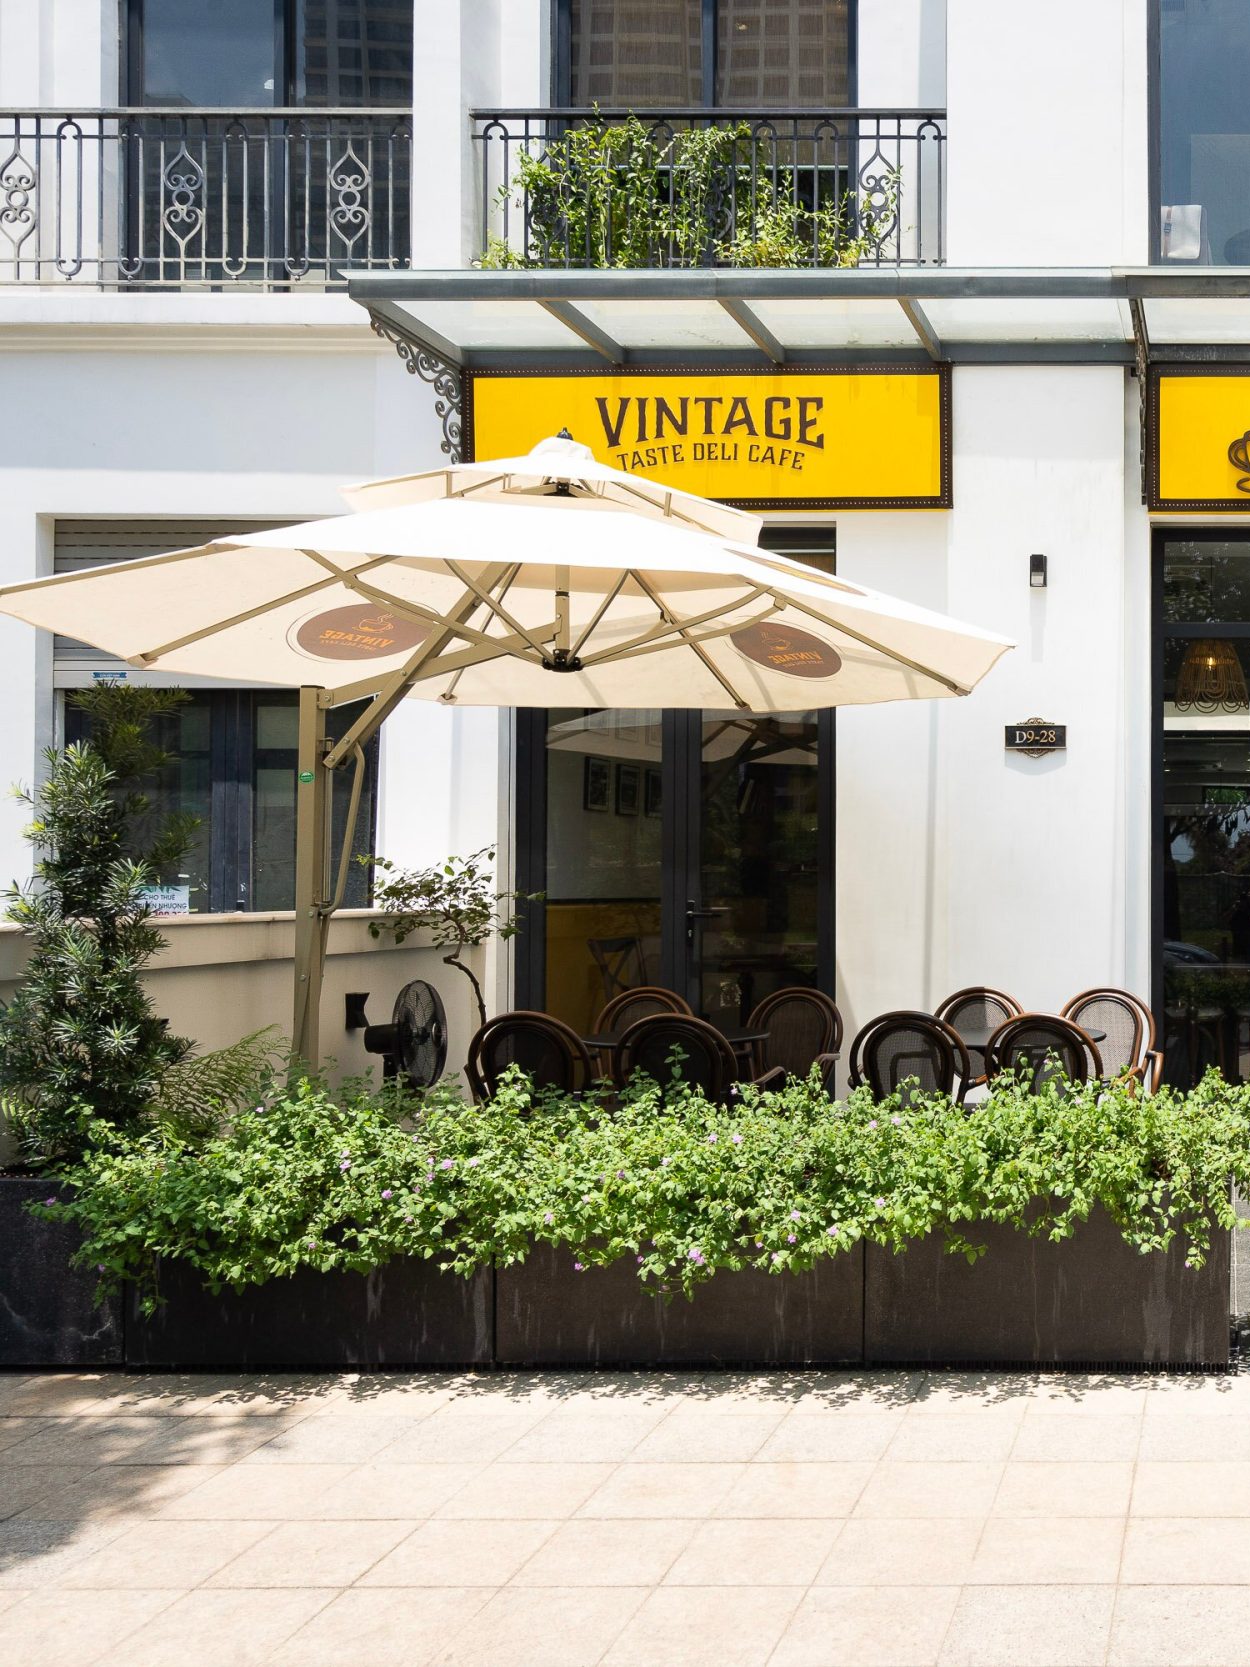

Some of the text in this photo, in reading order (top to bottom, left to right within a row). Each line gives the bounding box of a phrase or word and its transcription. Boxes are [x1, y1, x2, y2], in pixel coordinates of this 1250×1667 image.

[595, 396, 825, 450] VINTAGE
[617, 442, 805, 472] TASTE DELI CAFE
[1014, 729, 1056, 744] D9-28
